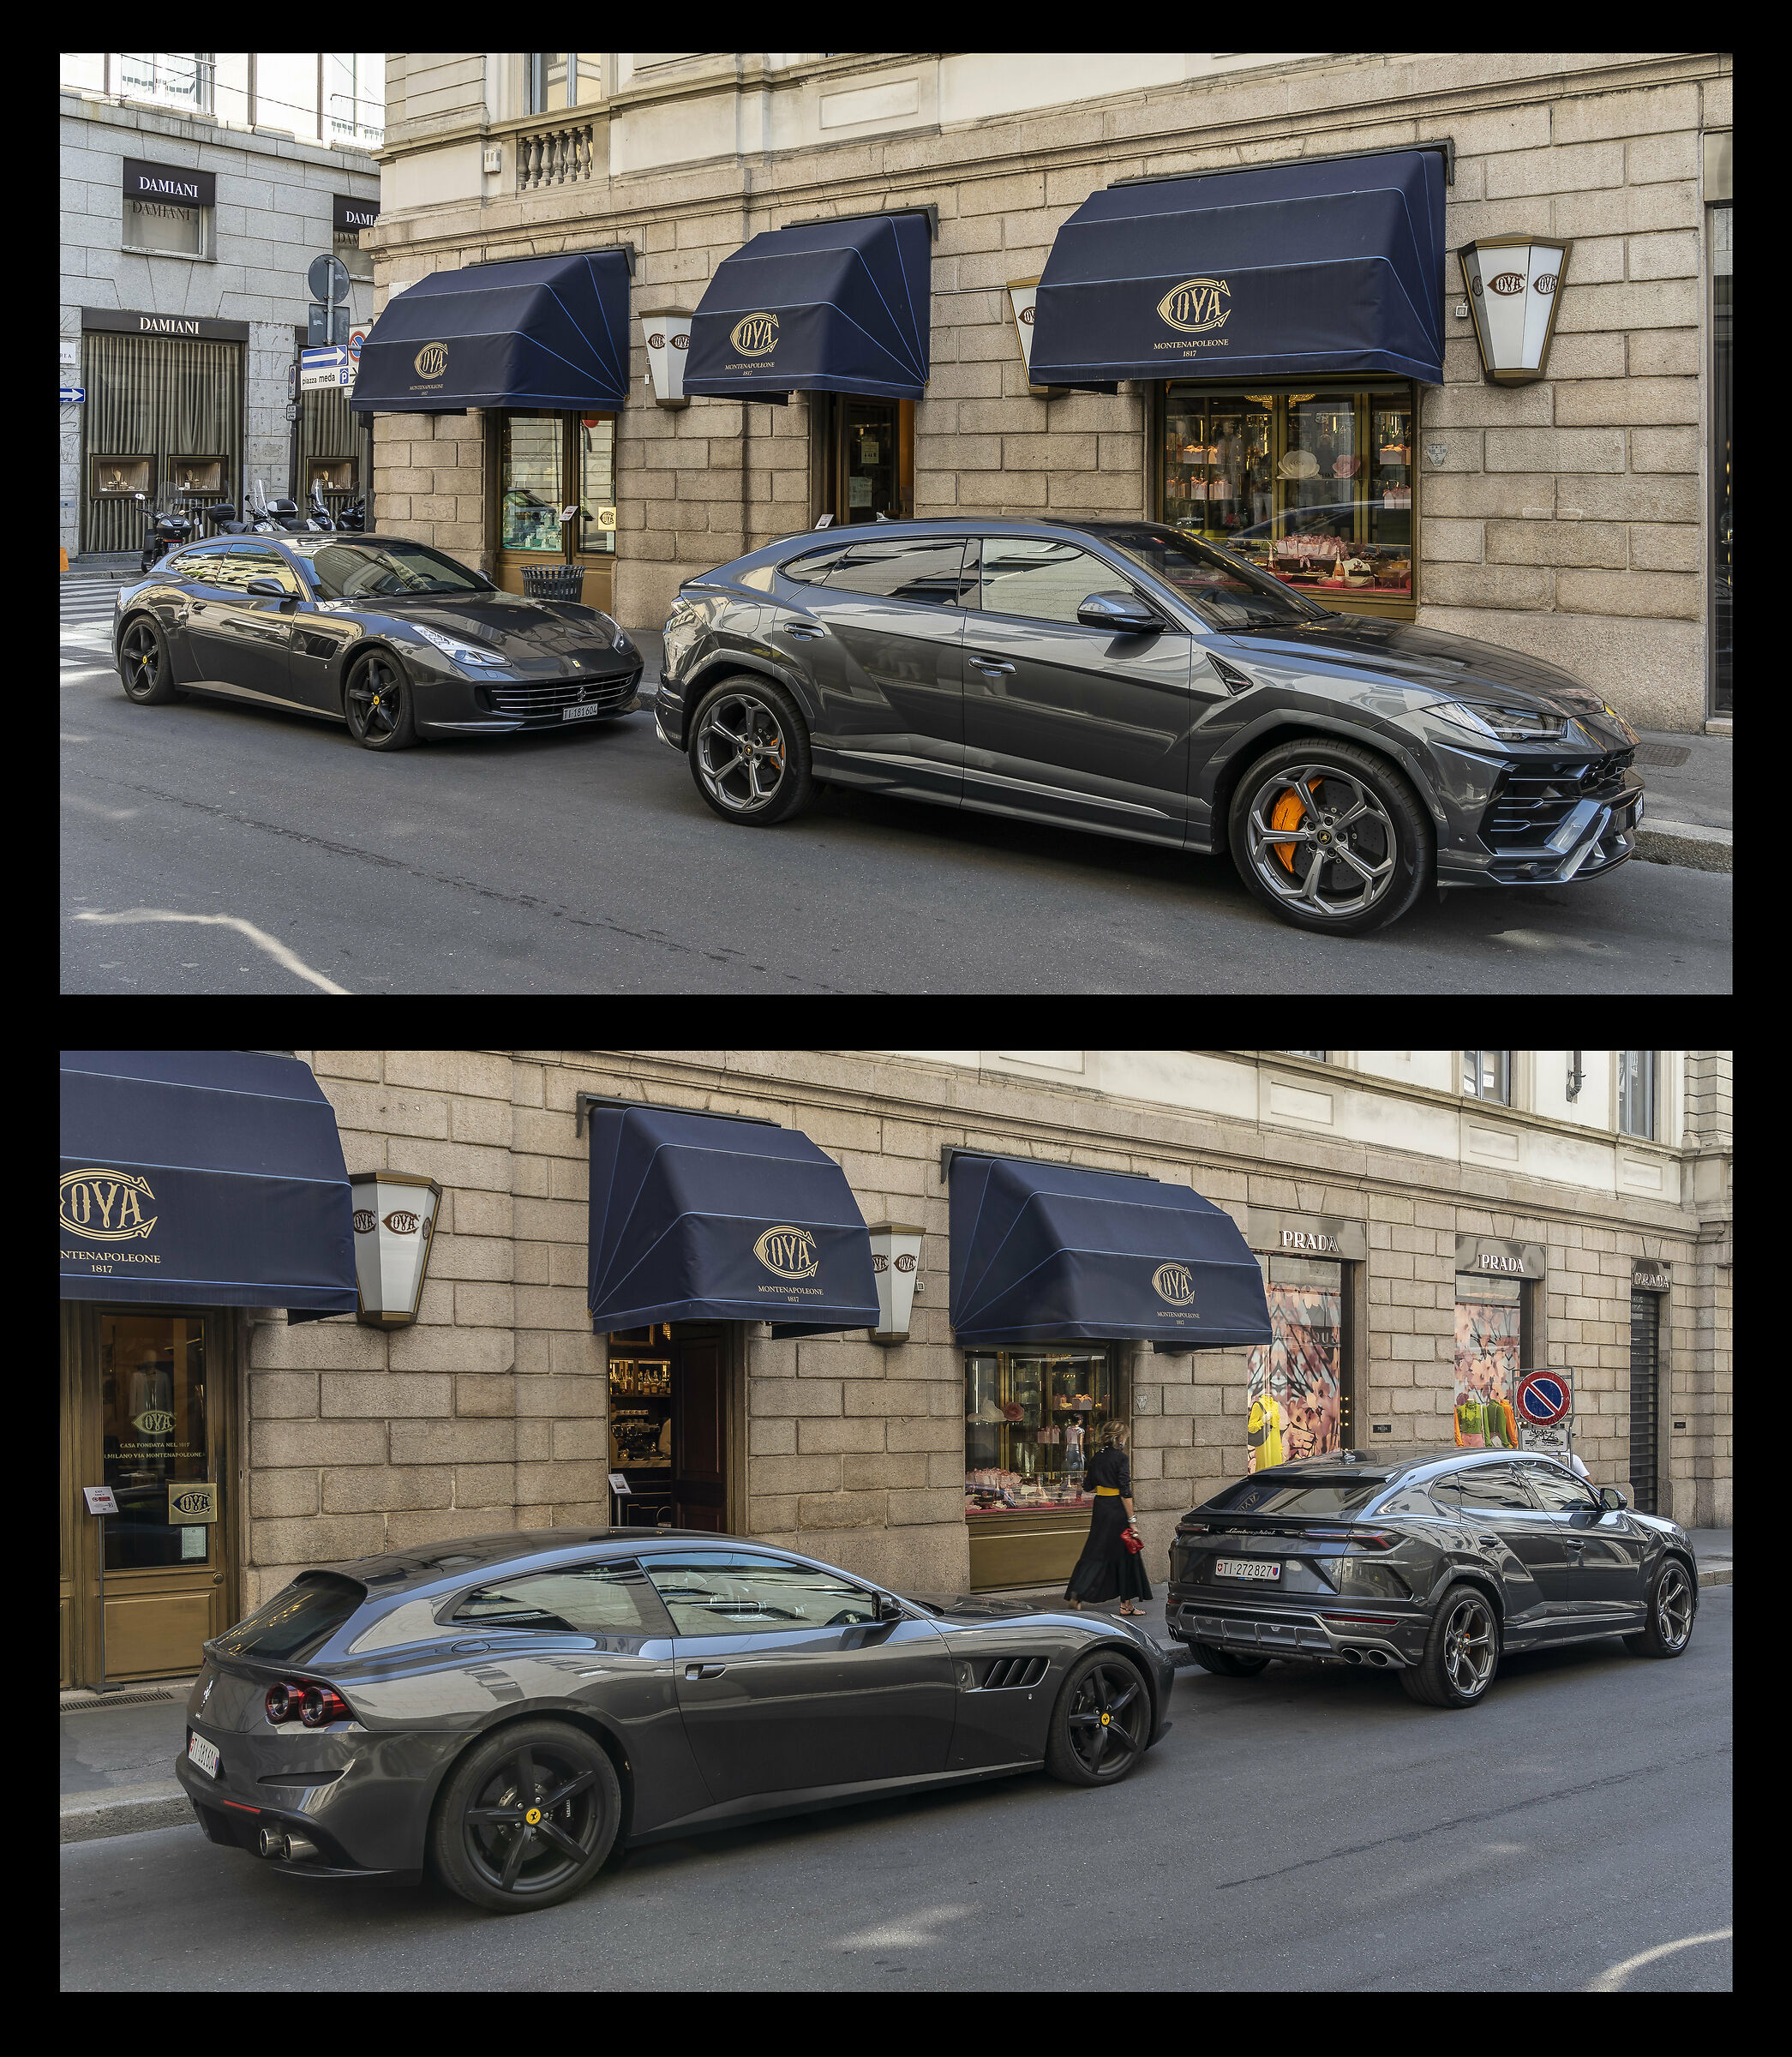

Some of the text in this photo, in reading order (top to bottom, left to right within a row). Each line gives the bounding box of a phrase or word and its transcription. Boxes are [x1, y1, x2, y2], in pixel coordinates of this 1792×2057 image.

[139, 177, 198, 197] DAMIANI
[345, 211, 378, 225] DAMI
[140, 317, 200, 334] DAMIANI
[1154, 339, 1229, 350] MONTENAPOLEONE
[724, 362, 775, 370] MONTENAPOLEONE
[302, 377, 317, 386] piazza
[318, 373, 336, 382] meda
[1280, 1230, 1339, 1251] PRADA
[91, 1264, 113, 1274] 1817
[1478, 1254, 1525, 1273] PRADA
[1632, 1272, 1669, 1288] PRADA
[758, 1286, 824, 1295] MONTENAPOLEONE
